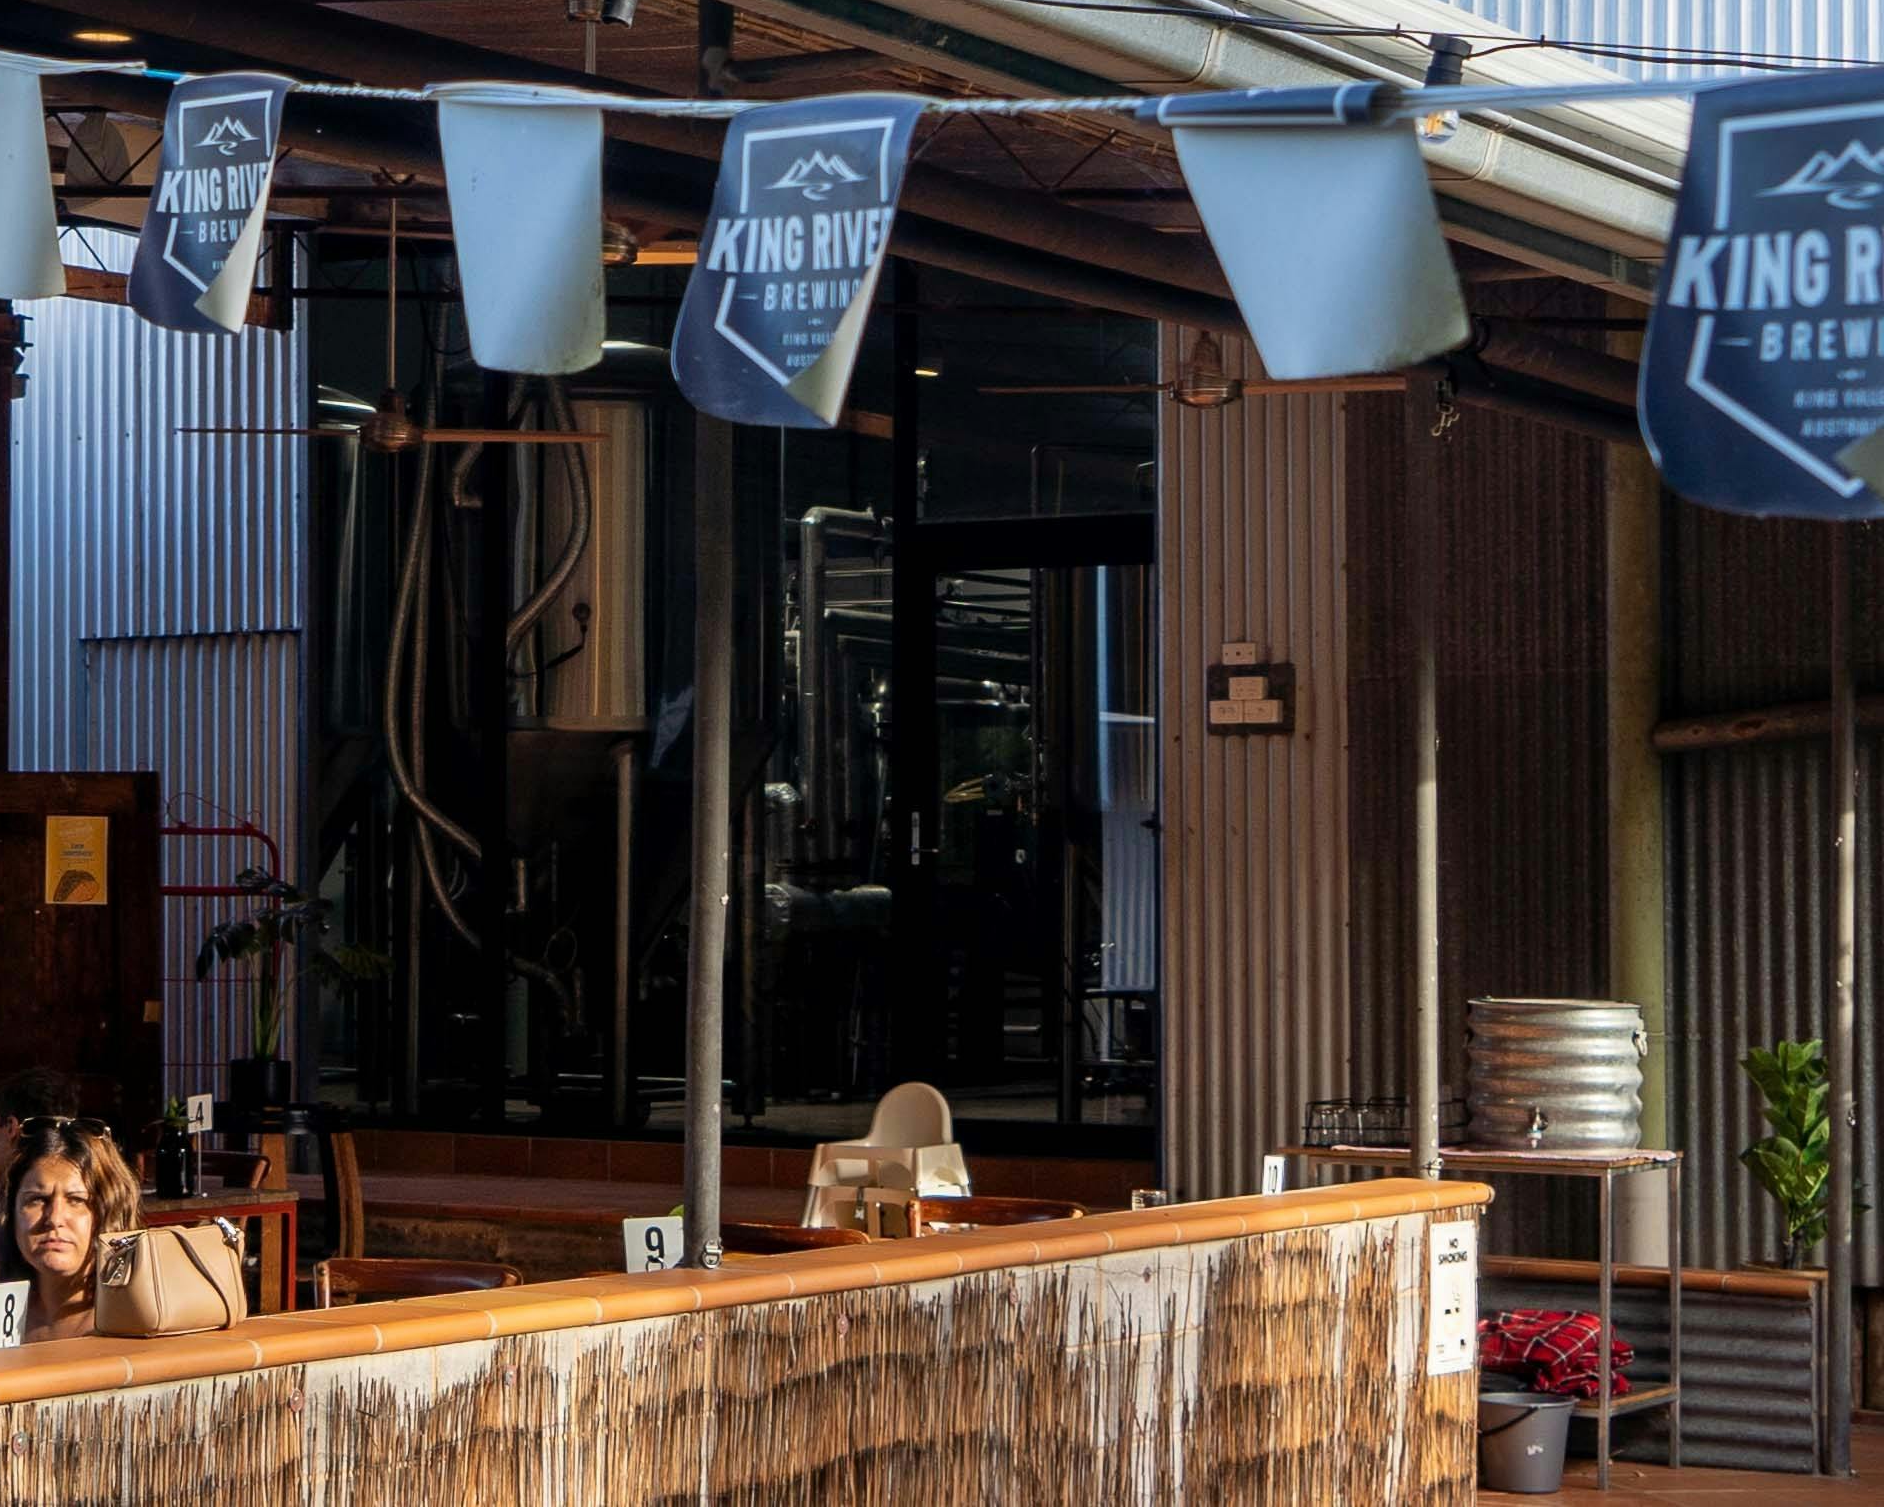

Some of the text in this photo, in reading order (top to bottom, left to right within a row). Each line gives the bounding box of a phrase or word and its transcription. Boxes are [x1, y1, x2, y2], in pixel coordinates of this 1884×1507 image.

[156, 162, 270, 213] KING RIVE
[706, 214, 805, 273] KING
[1667, 228, 1830, 311] KING
[645, 1226, 665, 1263] 9
[1448, 1237, 1459, 1249] NO
[3, 1293, 16, 1338] 8
